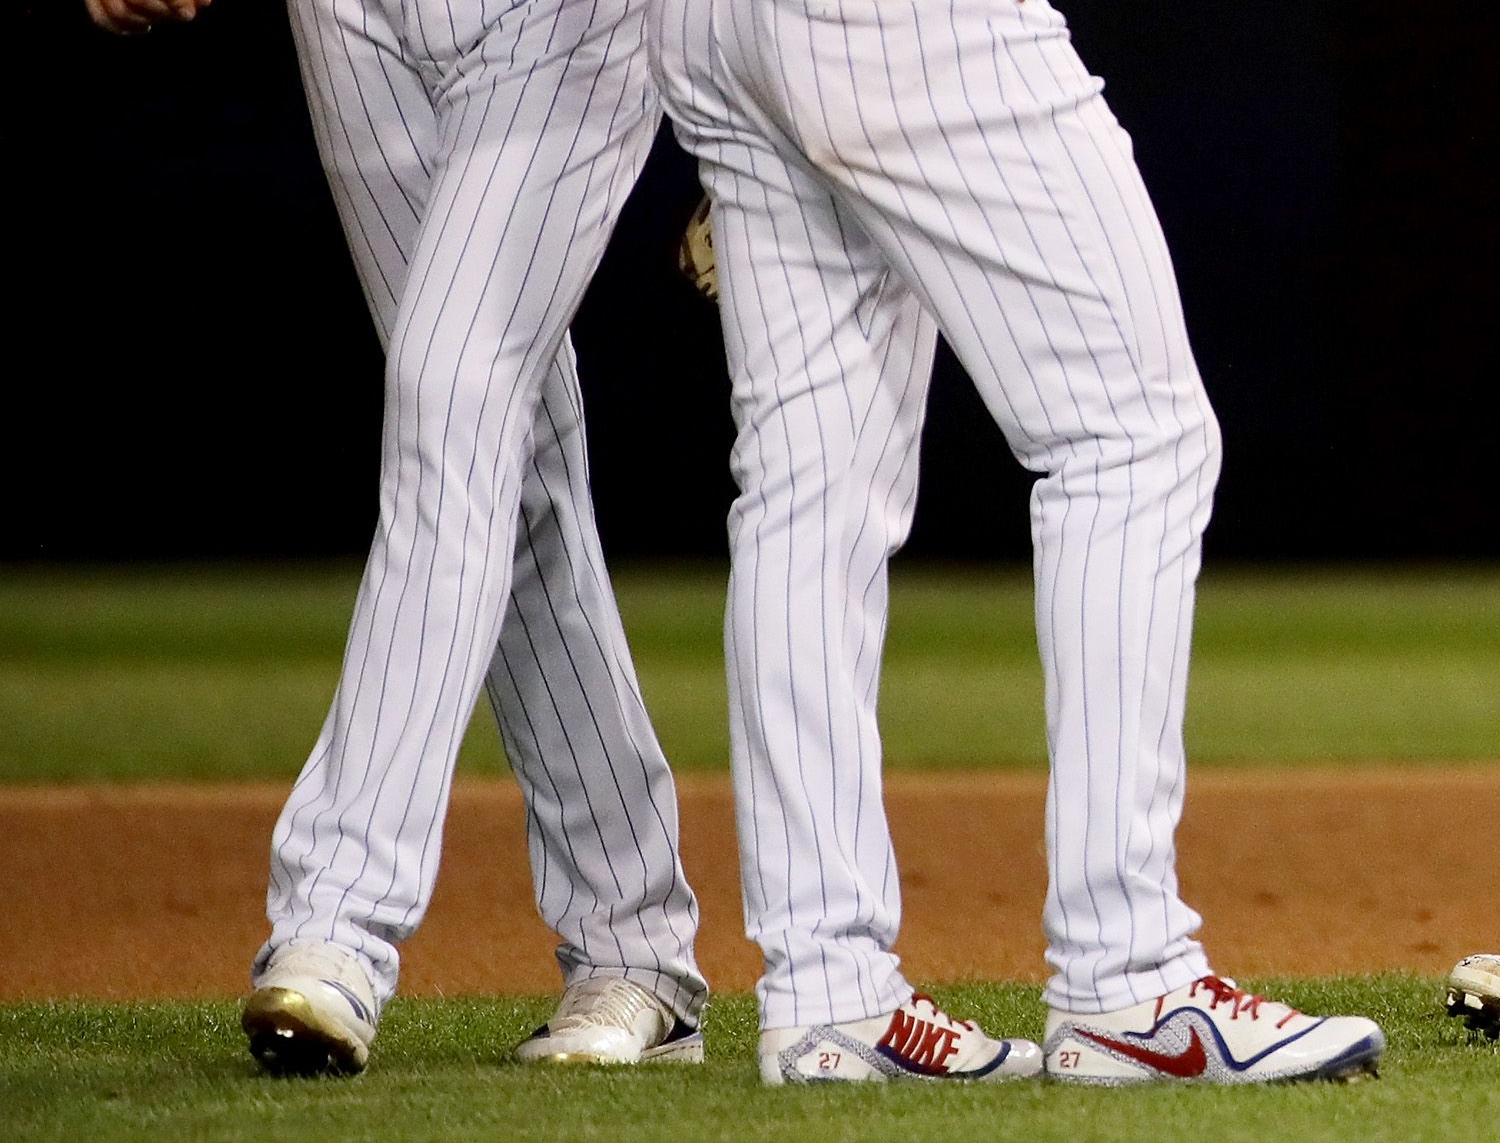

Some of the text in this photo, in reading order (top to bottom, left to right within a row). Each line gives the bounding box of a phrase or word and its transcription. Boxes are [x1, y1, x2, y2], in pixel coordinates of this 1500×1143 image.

[876, 1008, 961, 1075] NIKE
[819, 1052, 841, 1069] 27
[1060, 1051, 1080, 1068] 27
